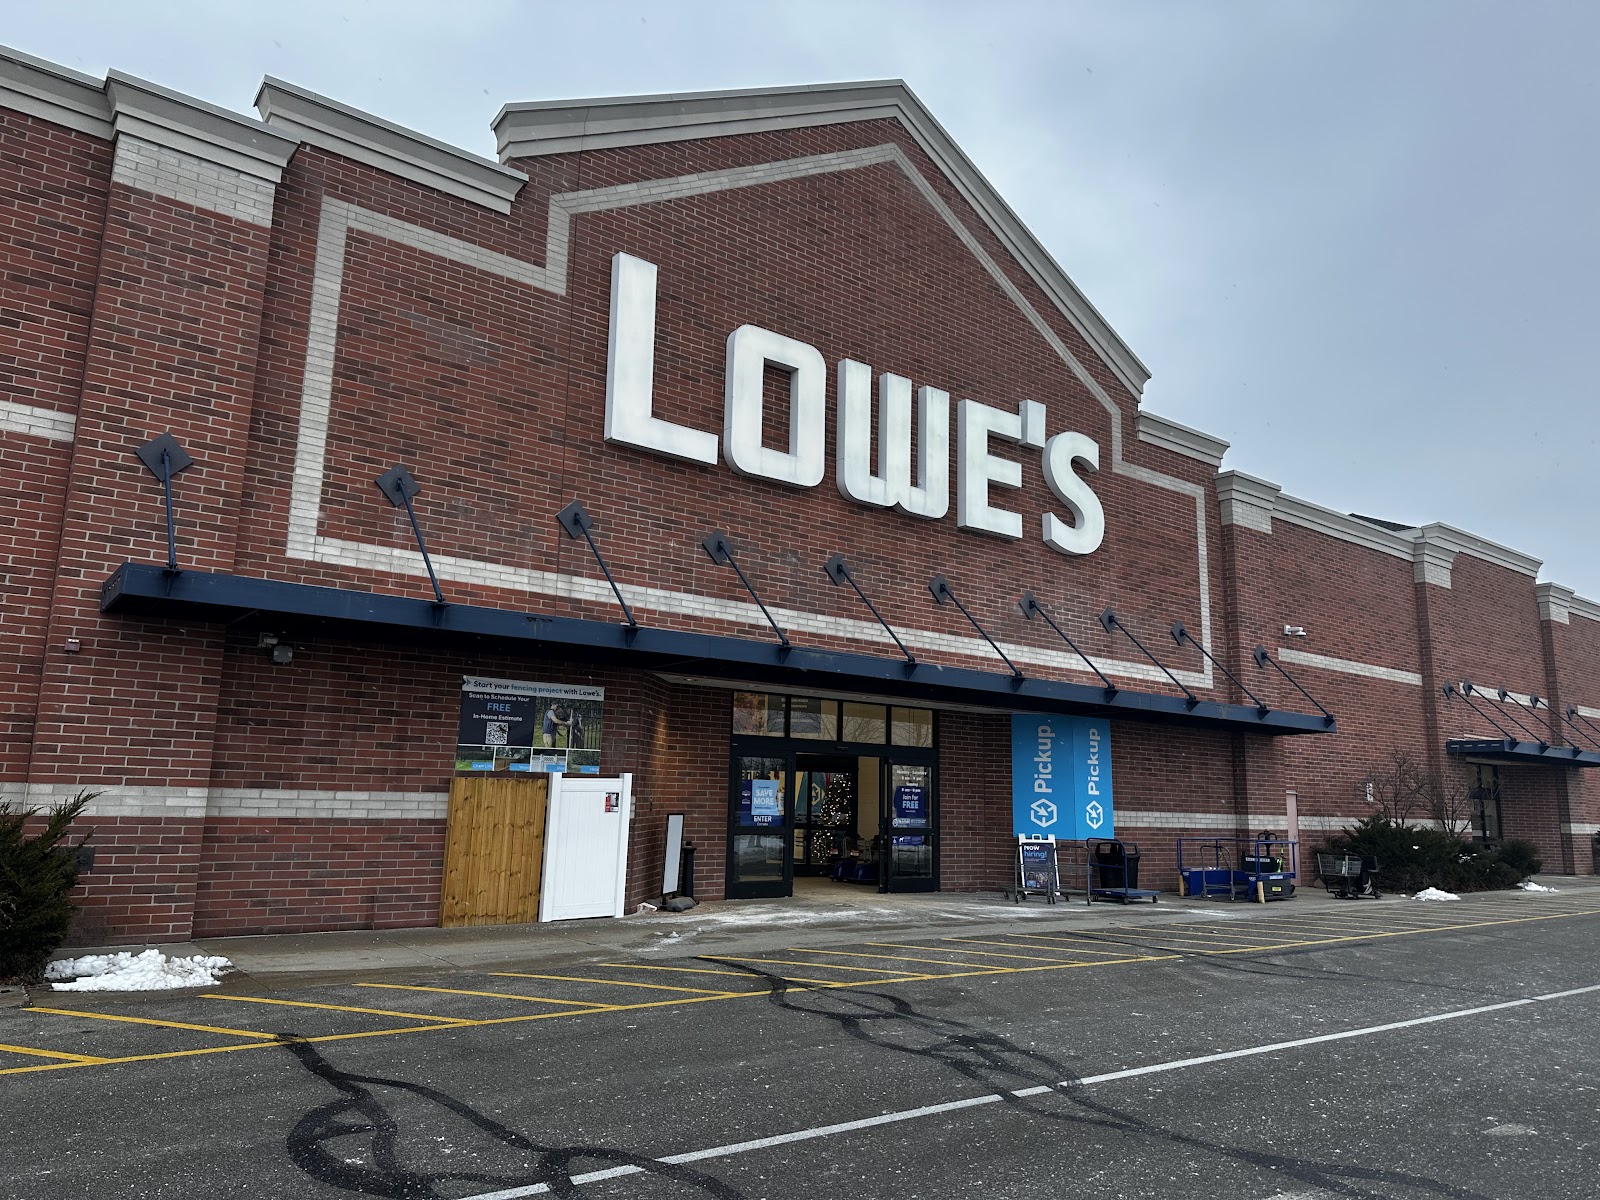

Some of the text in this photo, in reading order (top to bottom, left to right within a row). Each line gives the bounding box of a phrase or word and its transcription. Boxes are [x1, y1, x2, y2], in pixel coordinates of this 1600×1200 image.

[604, 251, 1105, 555] LOWE'S
[473, 680, 492, 688] Start
[511, 683, 537, 693] fencing
[538, 686, 562, 694] project
[487, 702, 511, 712] FREE
[1033, 725, 1056, 793] Pickup
[1087, 728, 1101, 796] Pickup
[755, 789, 773, 797] SAVE
[753, 797, 775, 805] MORE
[902, 801, 919, 809] FREE
[753, 815, 773, 823] ENTER
[1024, 850, 1048, 859] hiring!
